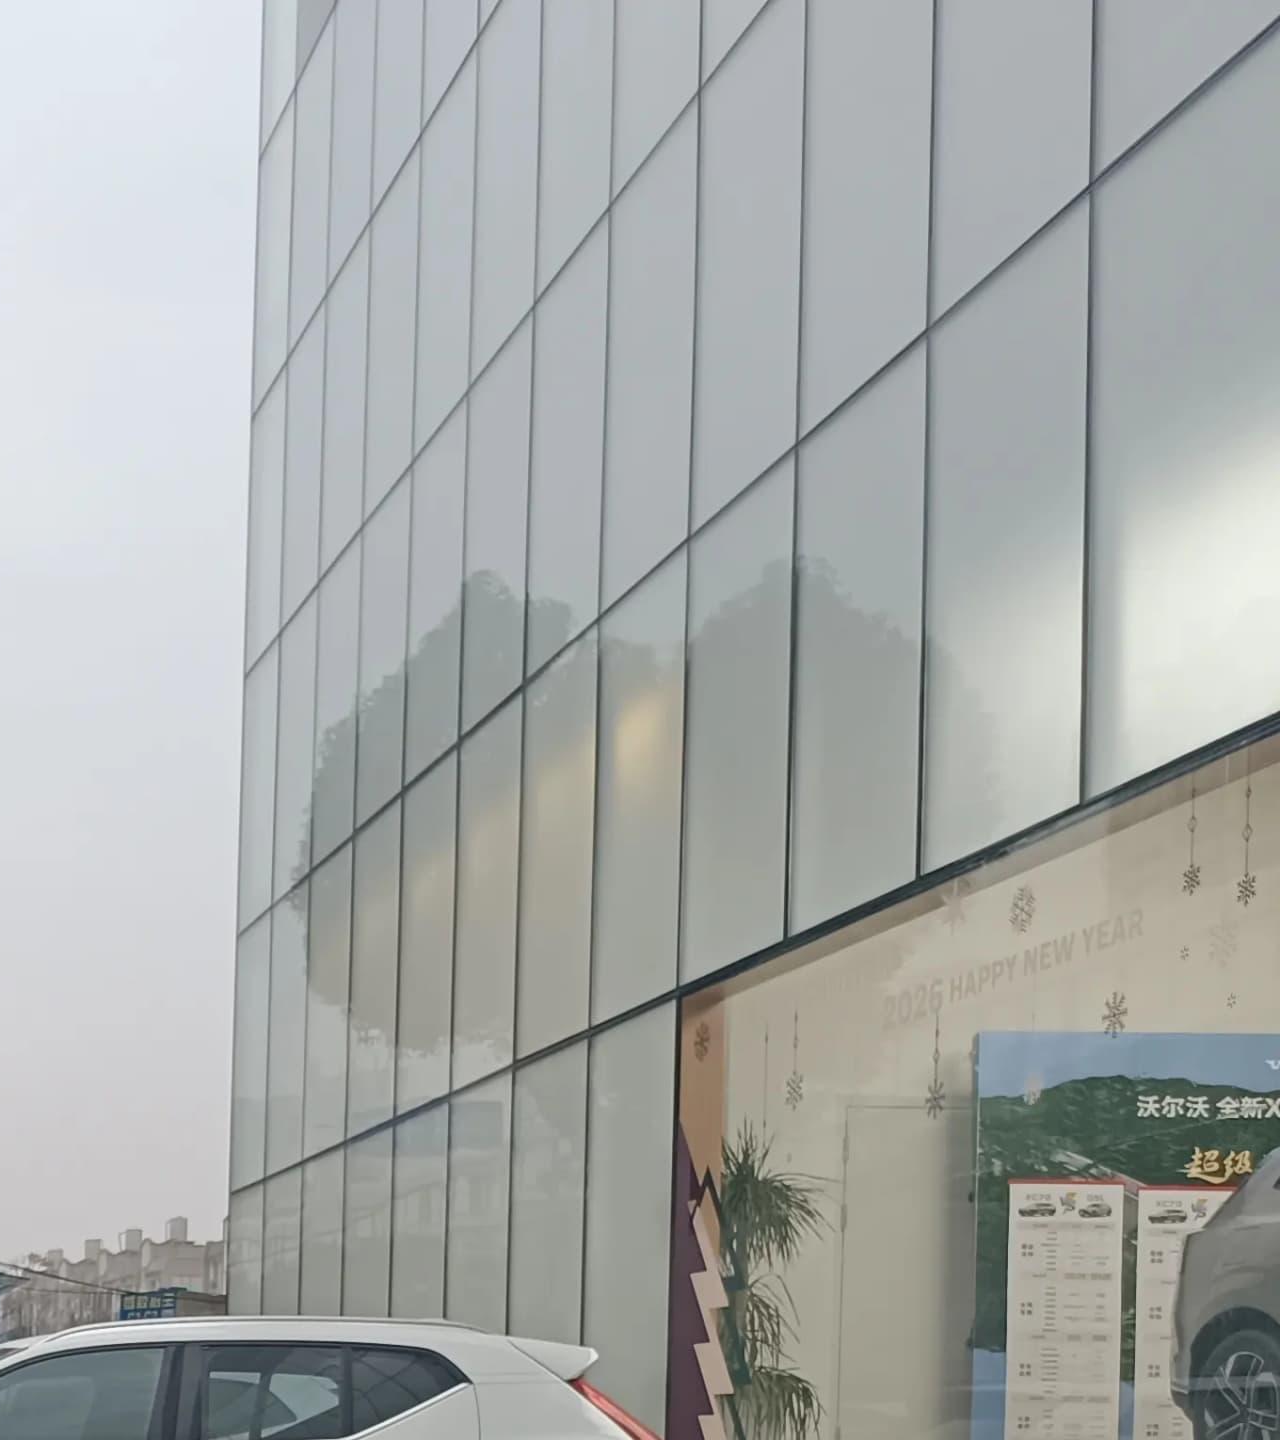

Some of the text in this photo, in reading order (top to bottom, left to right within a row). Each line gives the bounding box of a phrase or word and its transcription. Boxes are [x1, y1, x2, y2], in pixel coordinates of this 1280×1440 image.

[881, 908, 1145, 1030] 2026 HAPPY NEW YEAR
[1137, 1096, 1209, 1118] 沃尔沃
[1179, 1146, 1254, 1185] 超级
